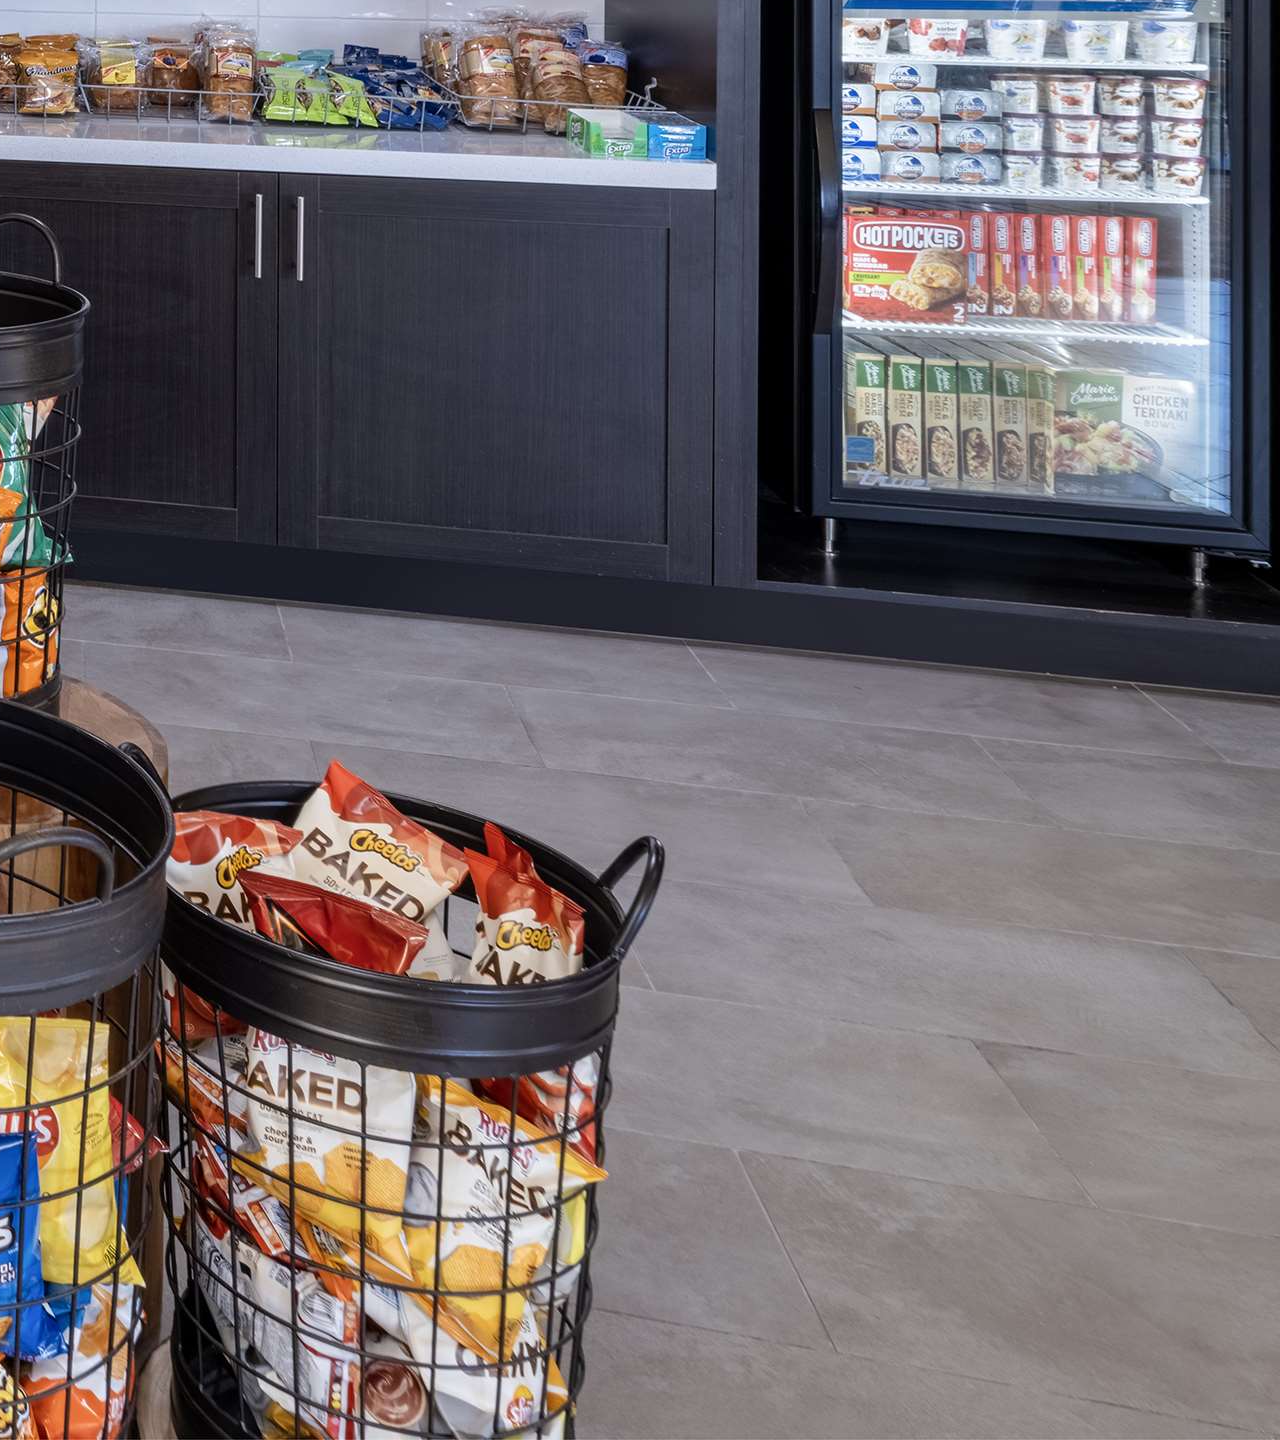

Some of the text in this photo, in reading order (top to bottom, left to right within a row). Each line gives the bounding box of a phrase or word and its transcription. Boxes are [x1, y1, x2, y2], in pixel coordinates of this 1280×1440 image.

[608, 143, 633, 153] Extra
[665, 146, 689, 157] Extra
[953, 305, 965, 319] 2
[1071, 383, 1116, 395] Marie
[1132, 394, 1189, 408] CHICKEN
[1134, 406, 1189, 421] TERIYAKI
[349, 829, 424, 873] Cheetos
[215, 845, 263, 890] Cheetos
[300, 826, 425, 924] BAKED
[496, 920, 553, 952] Cheetos
[246, 1060, 367, 1115] AKED
[263, 1133, 285, 1146] sour
